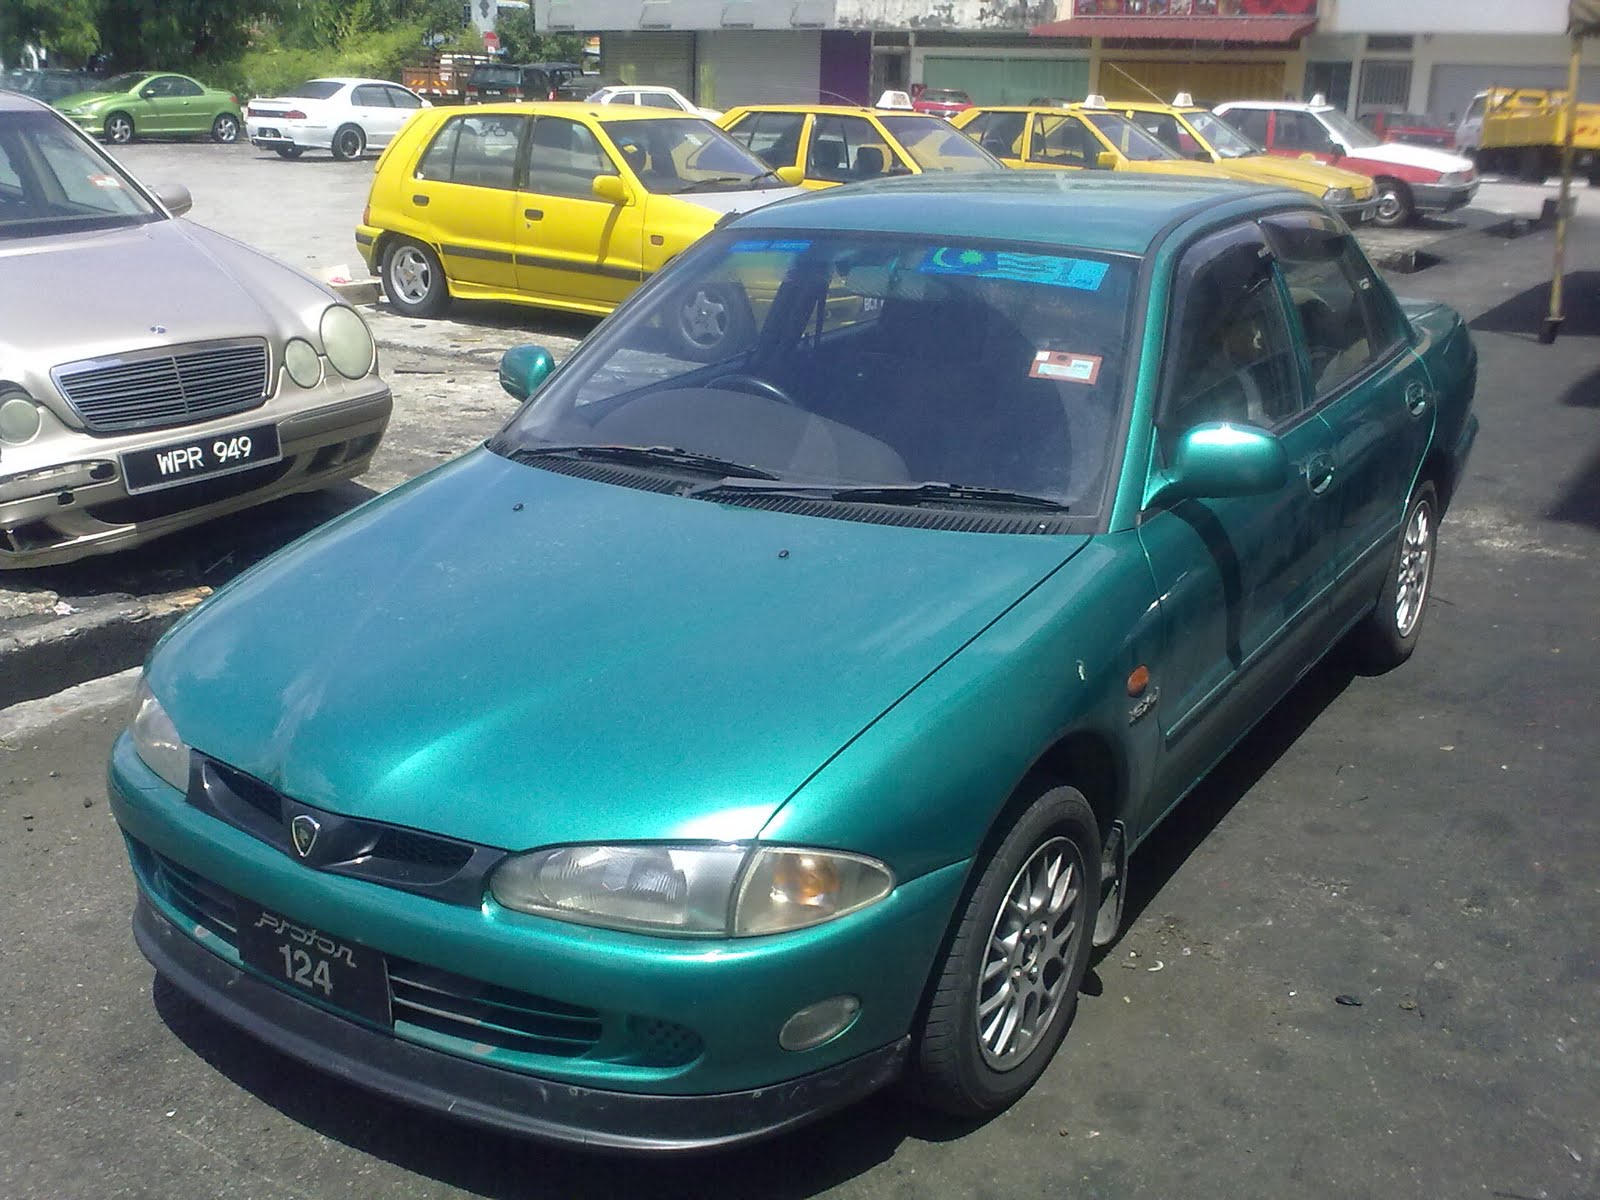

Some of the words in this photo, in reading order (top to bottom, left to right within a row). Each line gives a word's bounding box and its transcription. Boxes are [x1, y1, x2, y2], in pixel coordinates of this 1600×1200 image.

[156, 446, 205, 475] WPR
[213, 436, 252, 463] 949
[278, 944, 333, 996] 124
